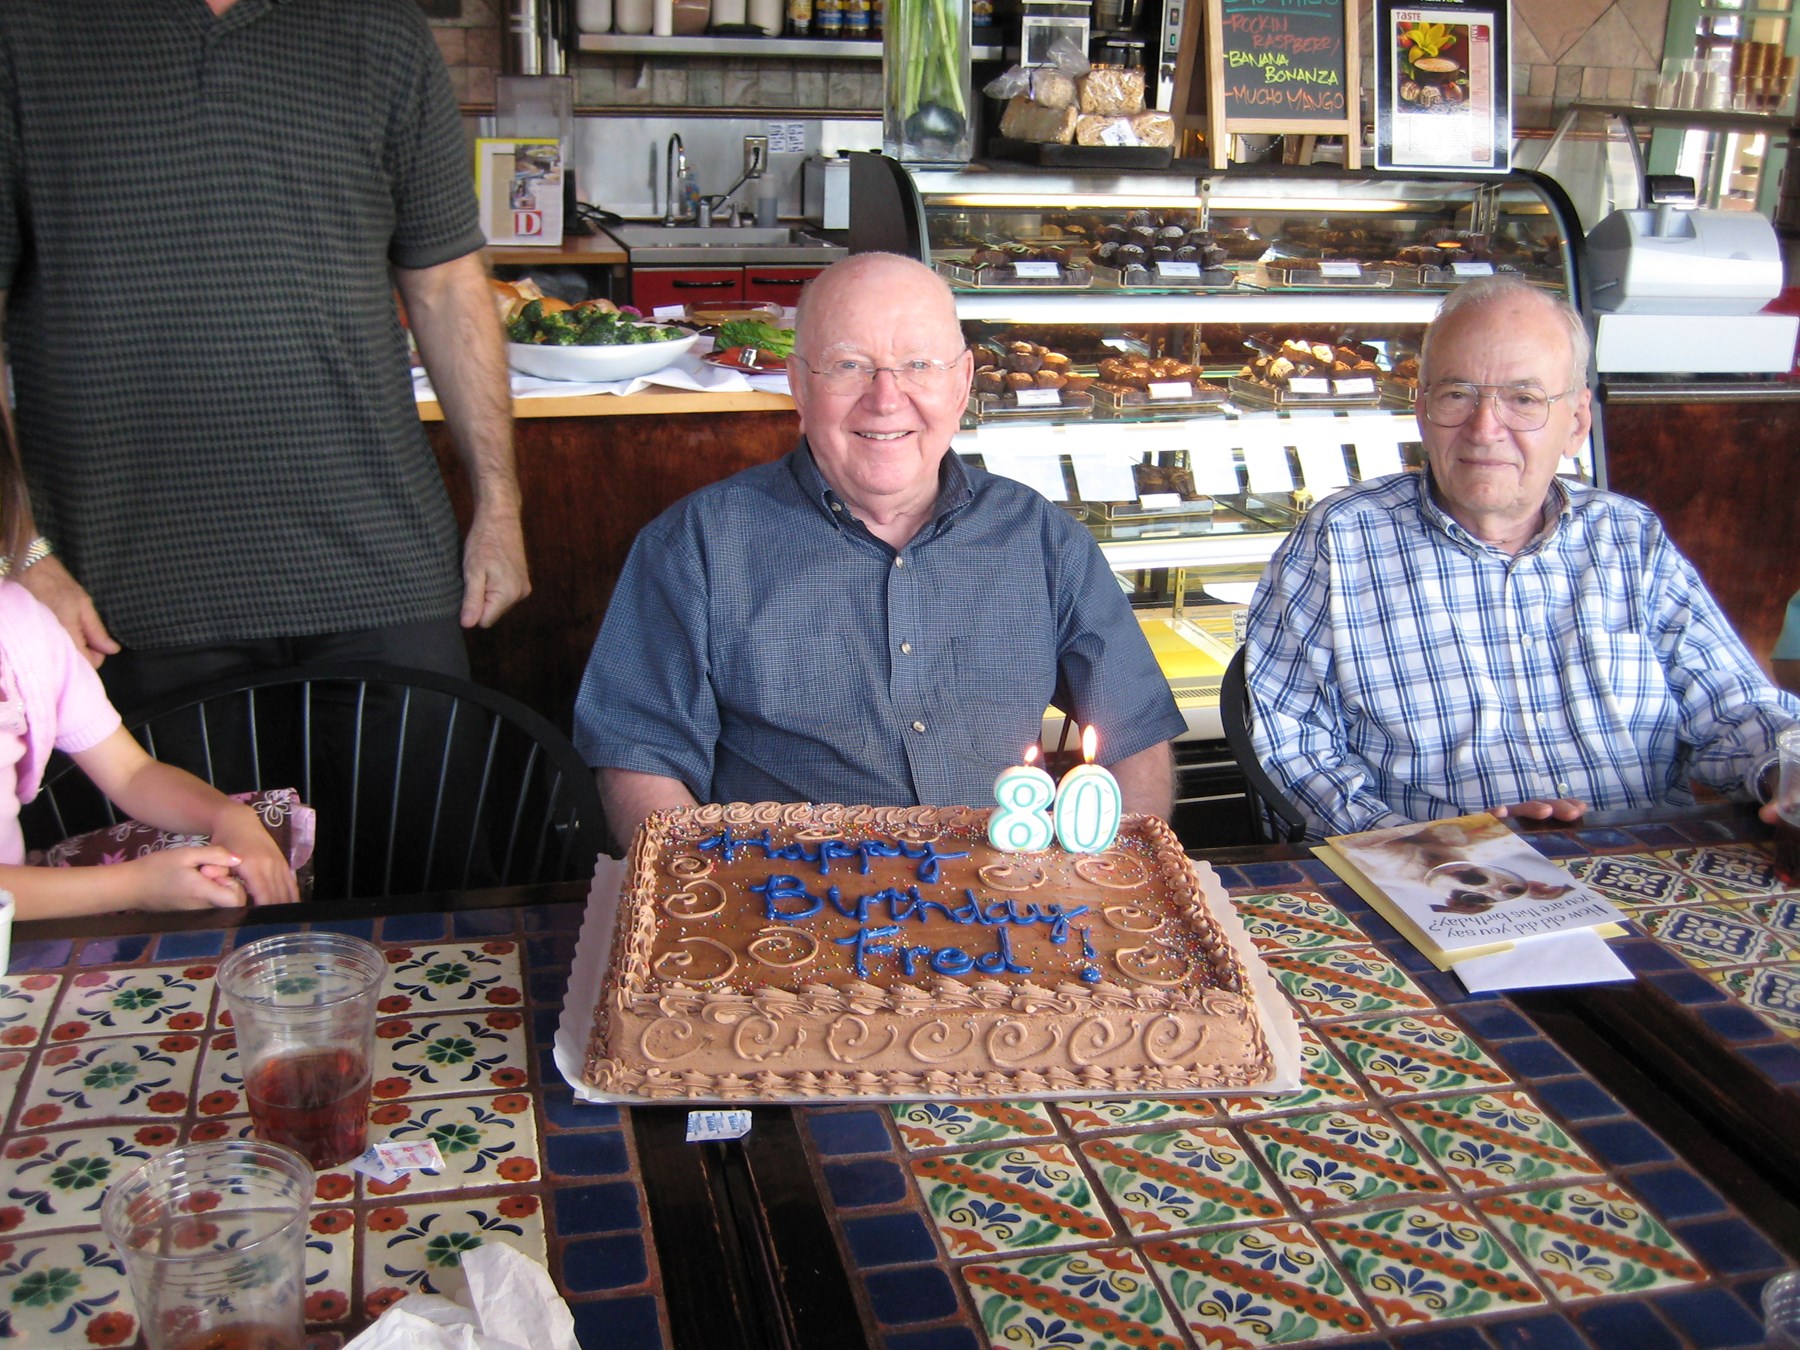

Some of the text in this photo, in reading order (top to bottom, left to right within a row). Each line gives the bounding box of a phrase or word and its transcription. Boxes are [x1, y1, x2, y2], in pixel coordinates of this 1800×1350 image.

[1264, 66, 1339, 86] BONANZA
[1286, 88, 1344, 112] MANGO
[517, 212, 541, 235] D
[988, 763, 1122, 854] 80
[698, 827, 971, 884] Happy
[750, 873, 1089, 944] Birthday
[1428, 893, 1597, 932] you are this birthday?
[1447, 904, 1609, 939] How old did you say
